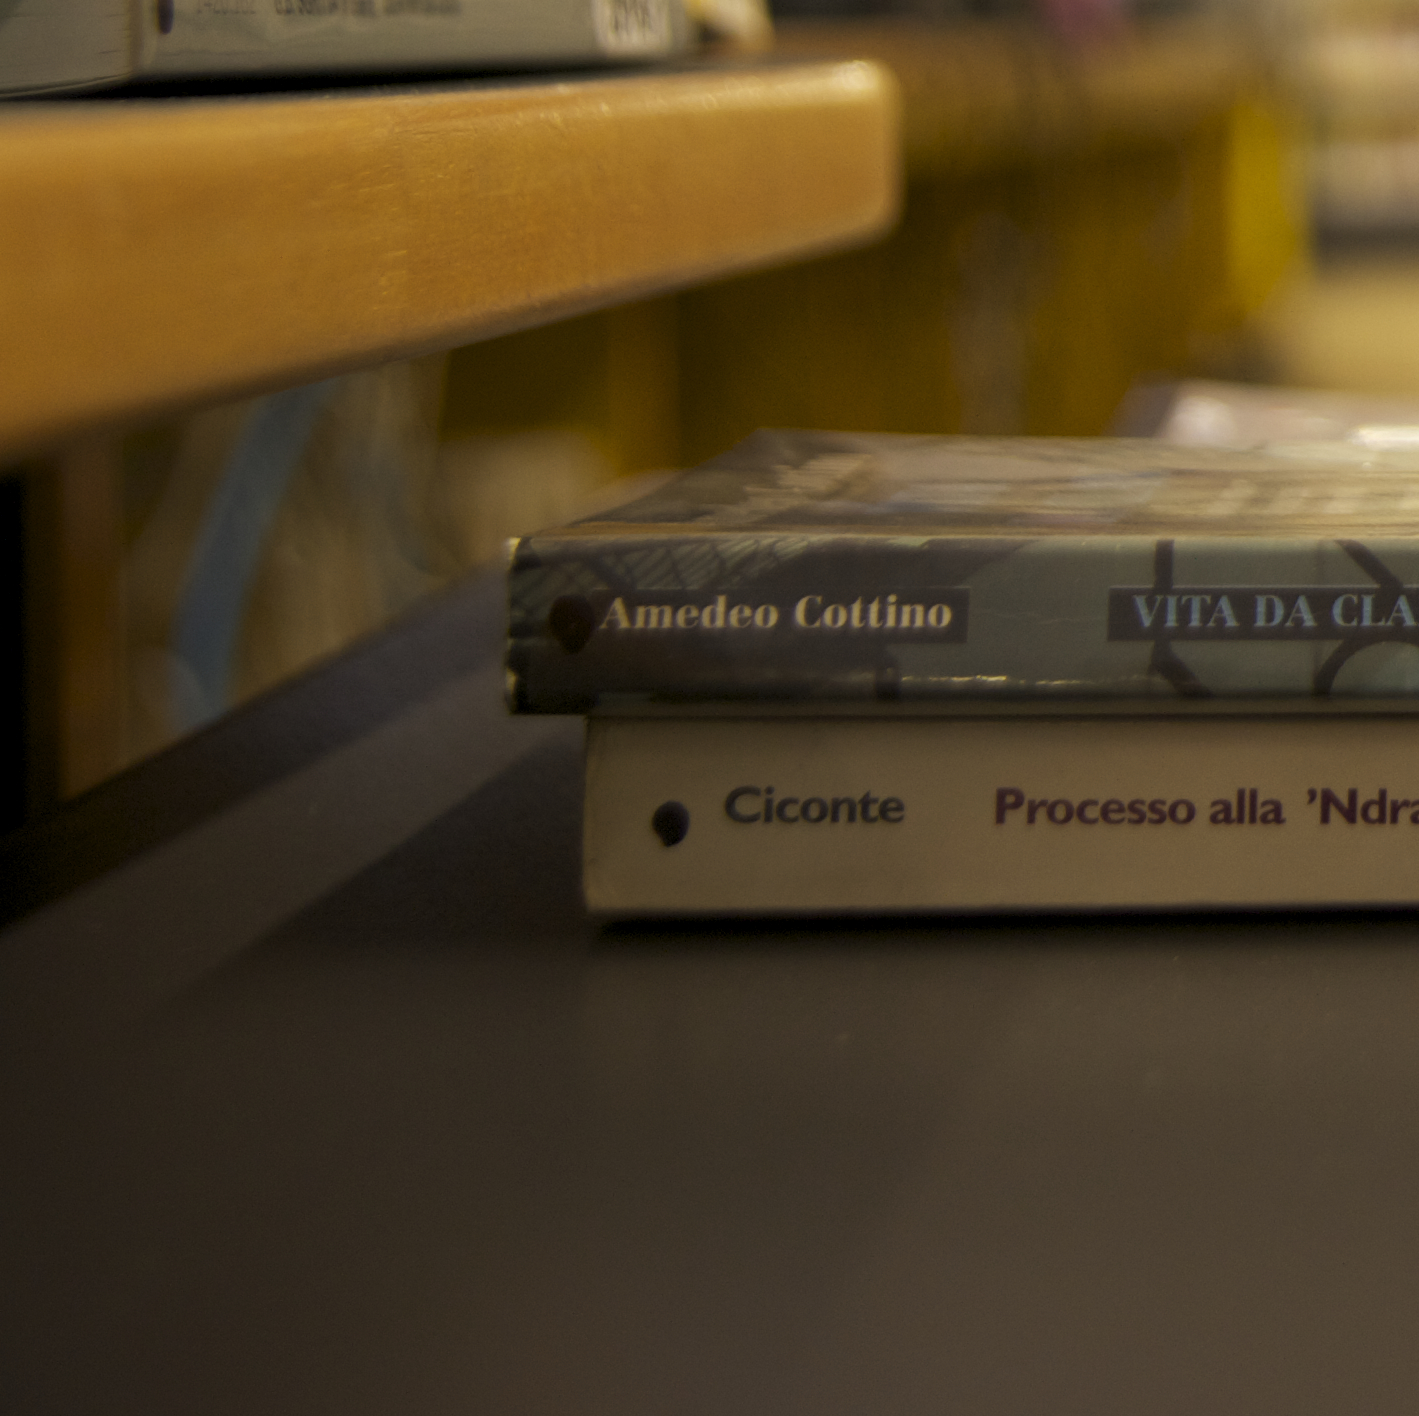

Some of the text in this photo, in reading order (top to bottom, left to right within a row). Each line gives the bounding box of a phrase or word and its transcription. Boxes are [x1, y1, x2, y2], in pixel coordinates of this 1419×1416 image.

[600, 593, 953, 630] Amedeo Cottino
[1132, 593, 1240, 628] VITA
[1254, 593, 1319, 628] DA
[723, 785, 907, 826] Ciconte
[995, 787, 1197, 827] Processo
[1209, 787, 1287, 827] alla
